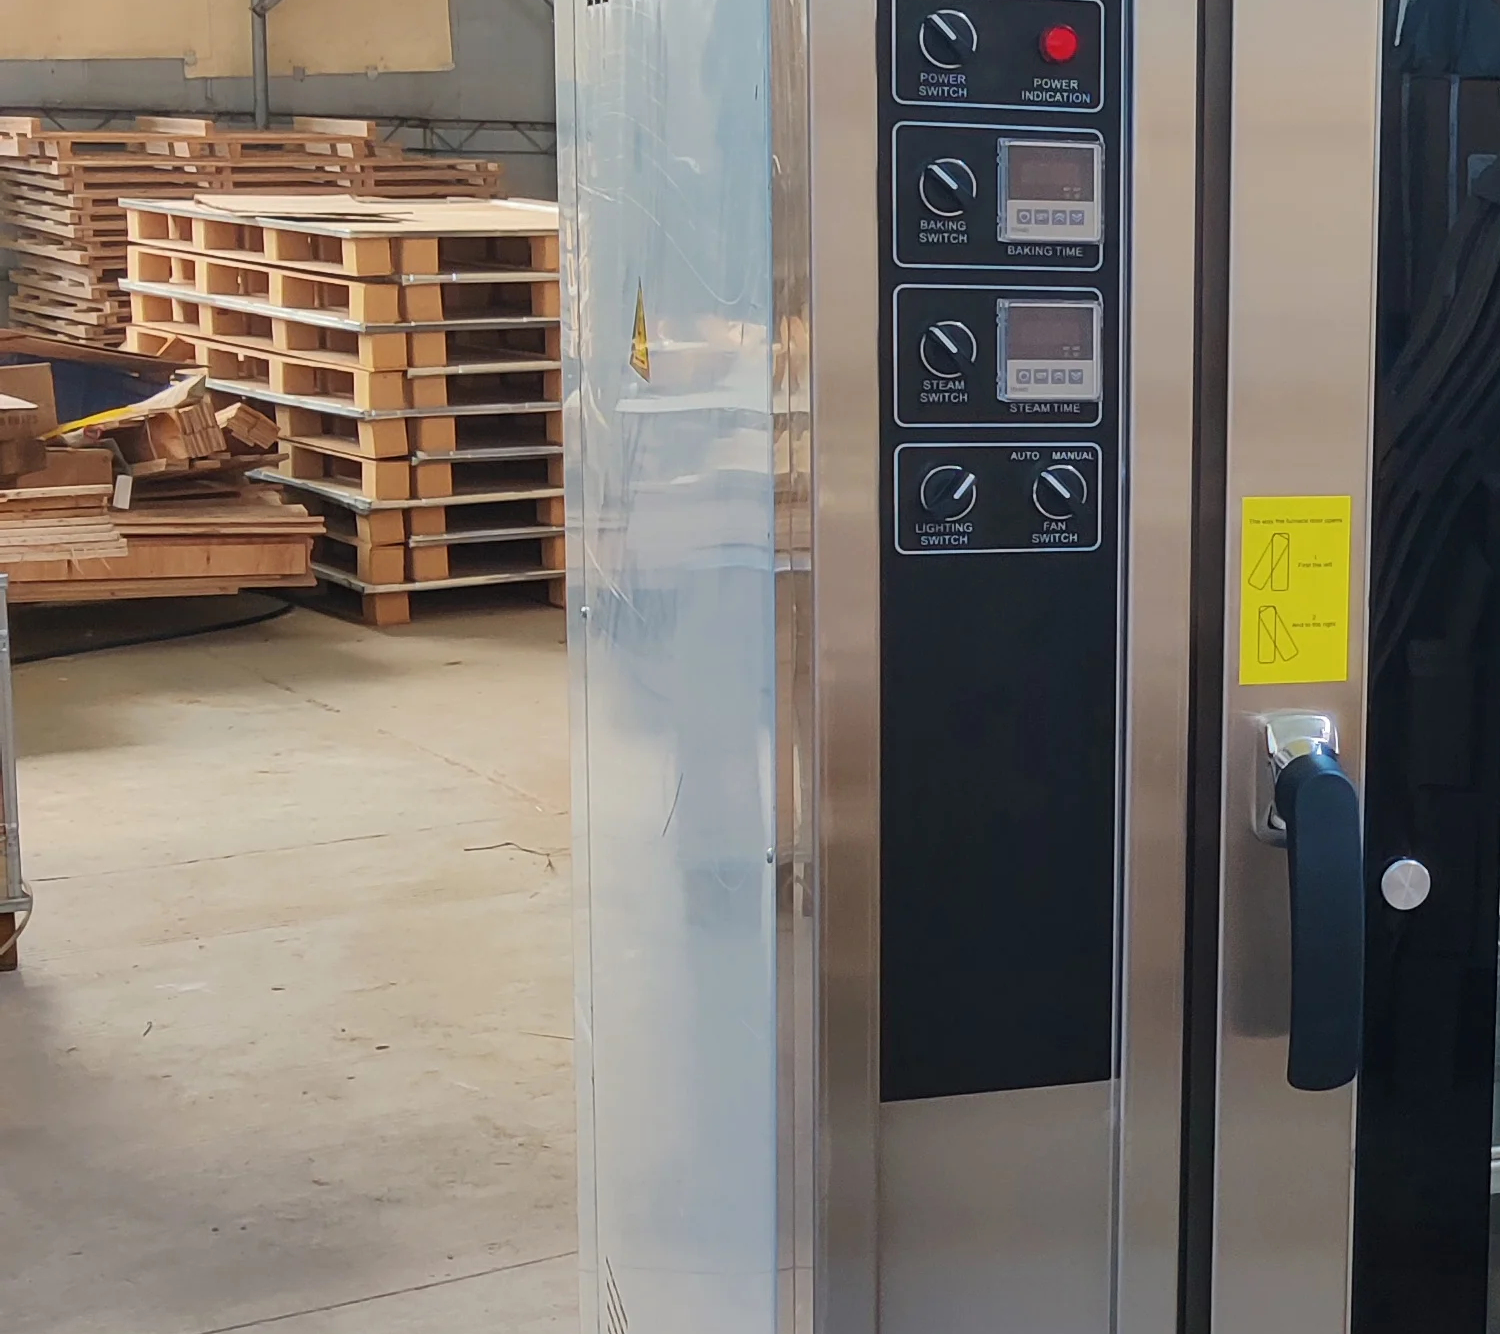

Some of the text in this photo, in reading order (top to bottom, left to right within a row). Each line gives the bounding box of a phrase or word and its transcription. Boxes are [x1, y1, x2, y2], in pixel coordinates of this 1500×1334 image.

[920, 73, 966, 85] POWER
[1034, 78, 1078, 90] POWER
[918, 85, 968, 98] SWITCH
[1021, 91, 1090, 103] INDICATION
[920, 220, 967, 231] BAKING
[918, 232, 968, 243] SWITCH
[1008, 245, 1083, 257] BAKING TIME
[922, 379, 965, 390] STEAM
[920, 392, 968, 403] SWITCH
[1009, 403, 1080, 413] STEAM TIME
[1010, 451, 1094, 461] AUTO MANUAL
[915, 523, 973, 533] LIGHTING
[1044, 521, 1066, 531] FAN
[920, 535, 968, 545] SWITCH
[1032, 533, 1078, 543] SWITCH
